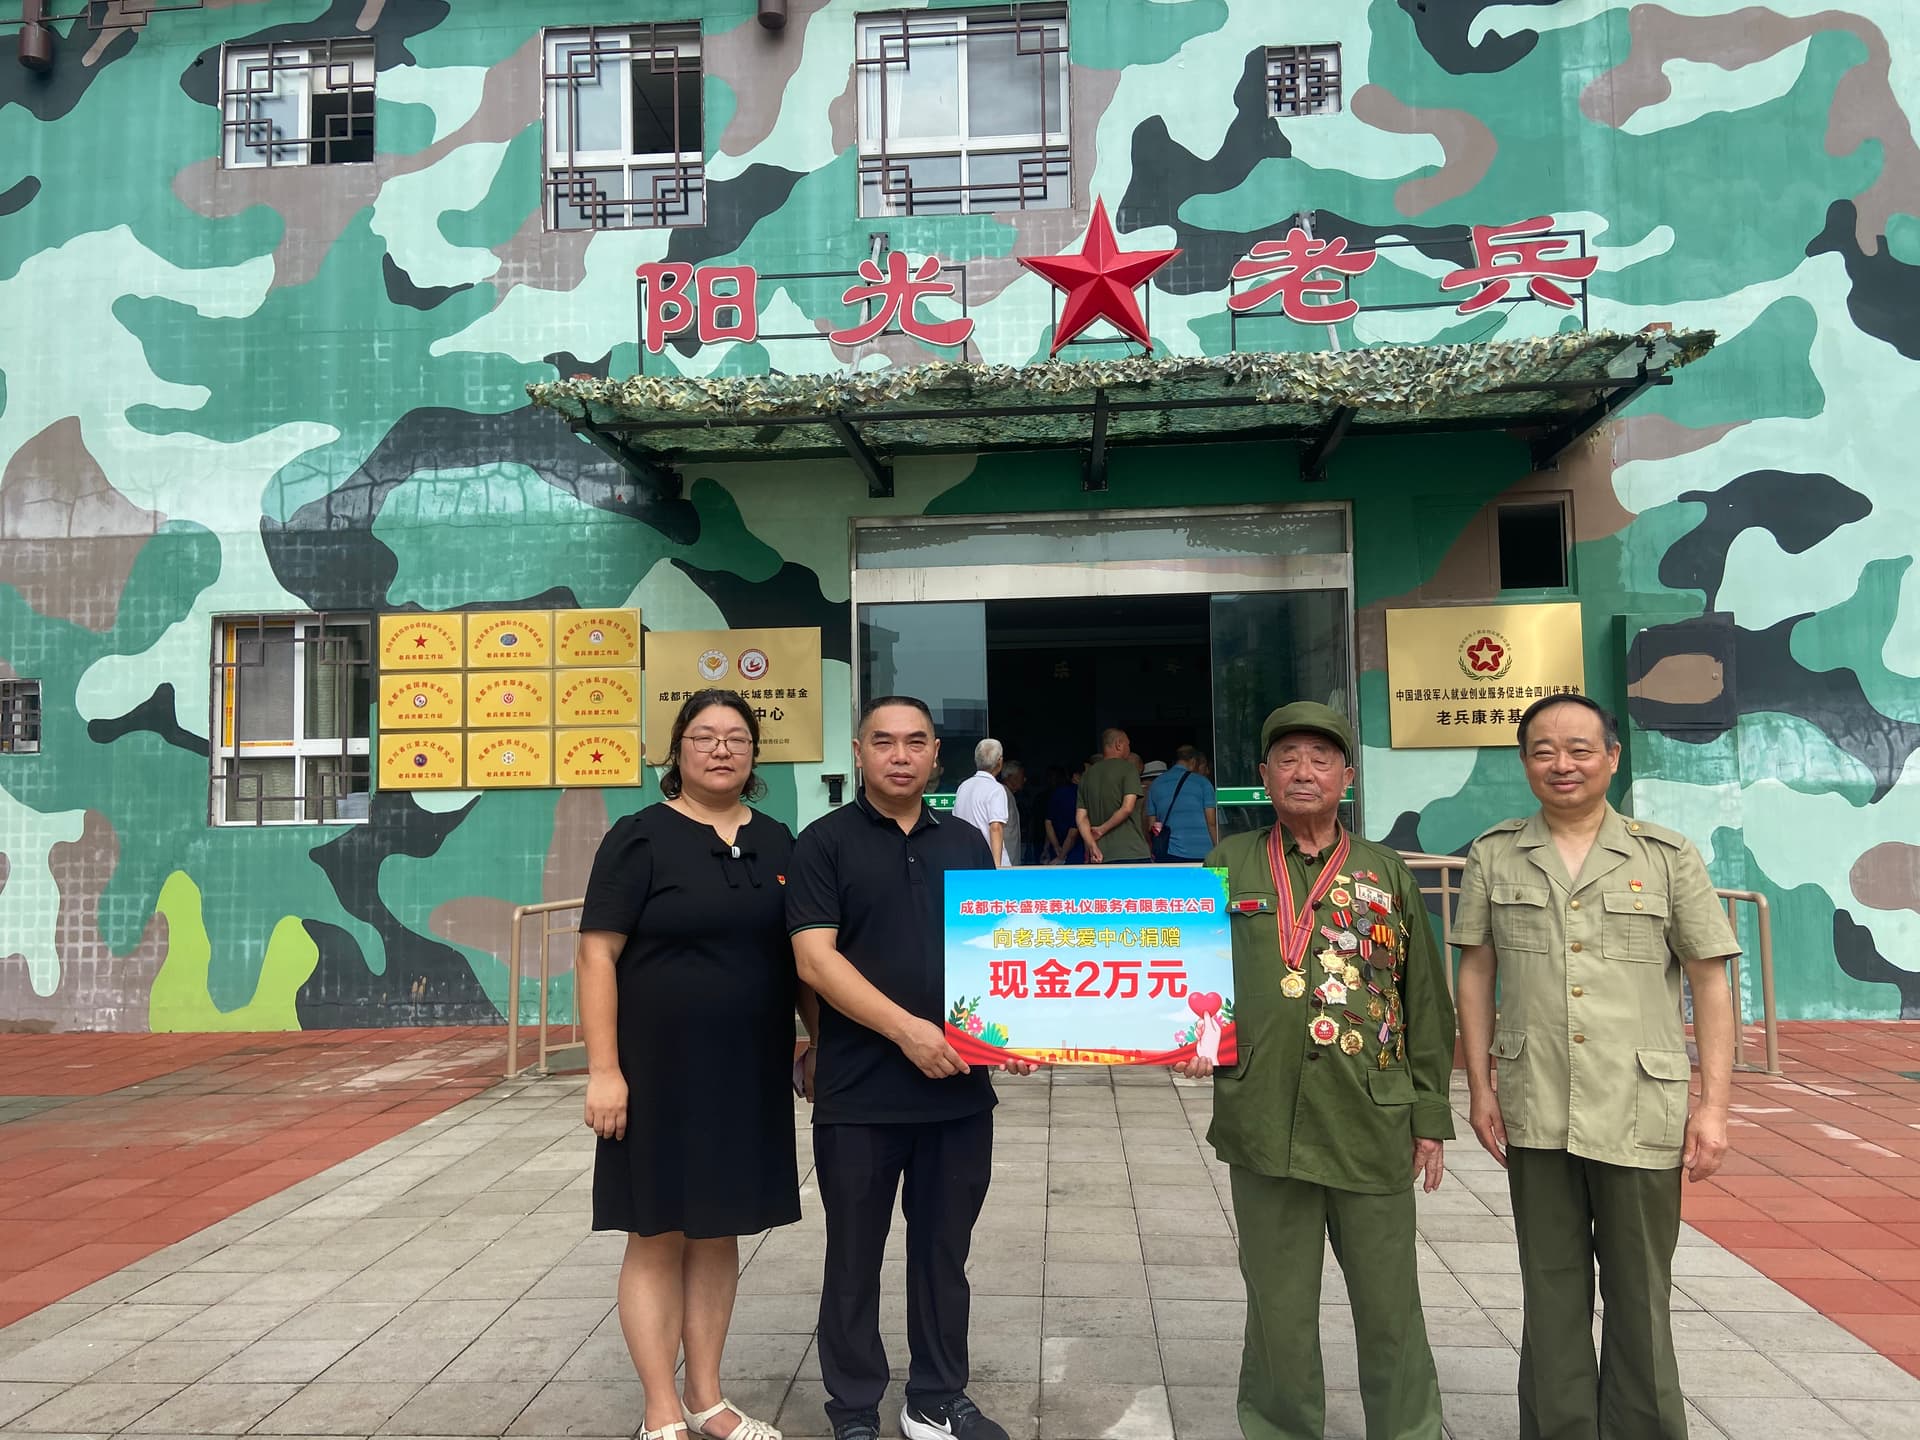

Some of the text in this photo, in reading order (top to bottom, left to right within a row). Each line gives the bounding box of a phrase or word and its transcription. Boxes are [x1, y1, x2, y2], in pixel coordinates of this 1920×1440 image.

[635, 215, 1599, 354] 阳光 老兵
[959, 898, 1216, 915] 成都市长盛殡葬礼仪服务有限责任公司
[992, 927, 1181, 949] 向老兵关爱中心捐赠
[988, 958, 1189, 1000] 现金2万元
